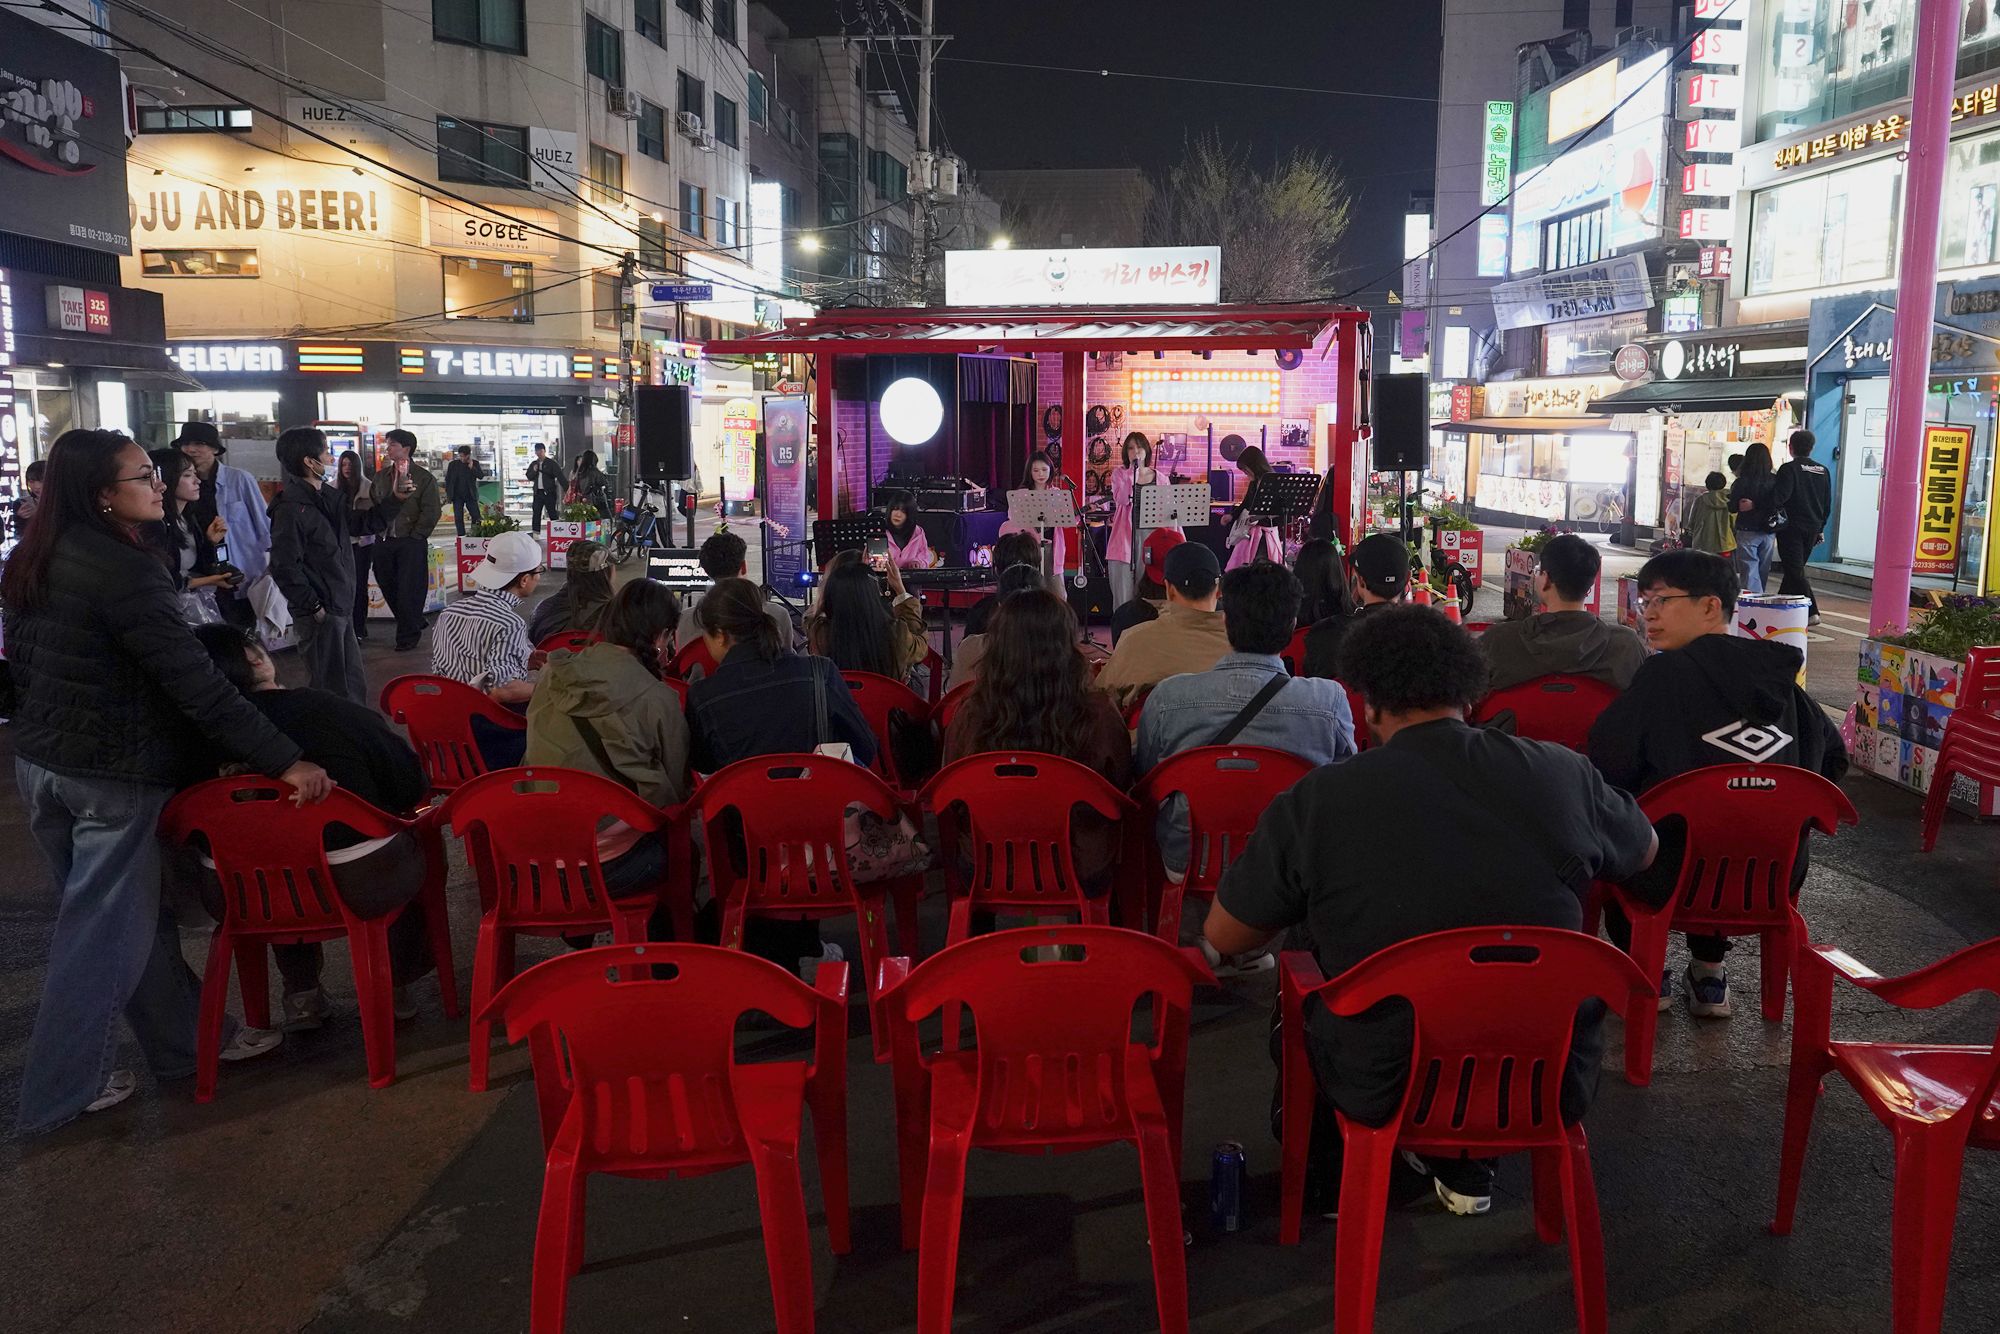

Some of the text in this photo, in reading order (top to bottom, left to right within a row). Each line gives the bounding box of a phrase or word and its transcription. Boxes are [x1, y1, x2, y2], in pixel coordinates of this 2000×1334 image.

[303, 106, 346, 121] HUE.Z
[1491, 123, 1507, 143] 술
[1811, 134, 1837, 159] 모든
[1840, 123, 1868, 150] 야한
[1871, 115, 1902, 142] 속옷
[535, 147, 573, 164] HUE.Z
[1487, 154, 1507, 195] 노래방
[195, 190, 265, 231] AND
[276, 189, 379, 231] BEER!
[465, 219, 528, 241] SOBEE
[1148, 259, 1211, 288] 버스킹
[61, 300, 83, 314] TAKE
[90, 299, 105, 311] 325
[65, 314, 81, 327] OUT
[783, 384, 801, 392] OPEN
[736, 431, 751, 482] 노래방
[779, 446, 793, 460] R5
[1924, 447, 1960, 533] 부동산
